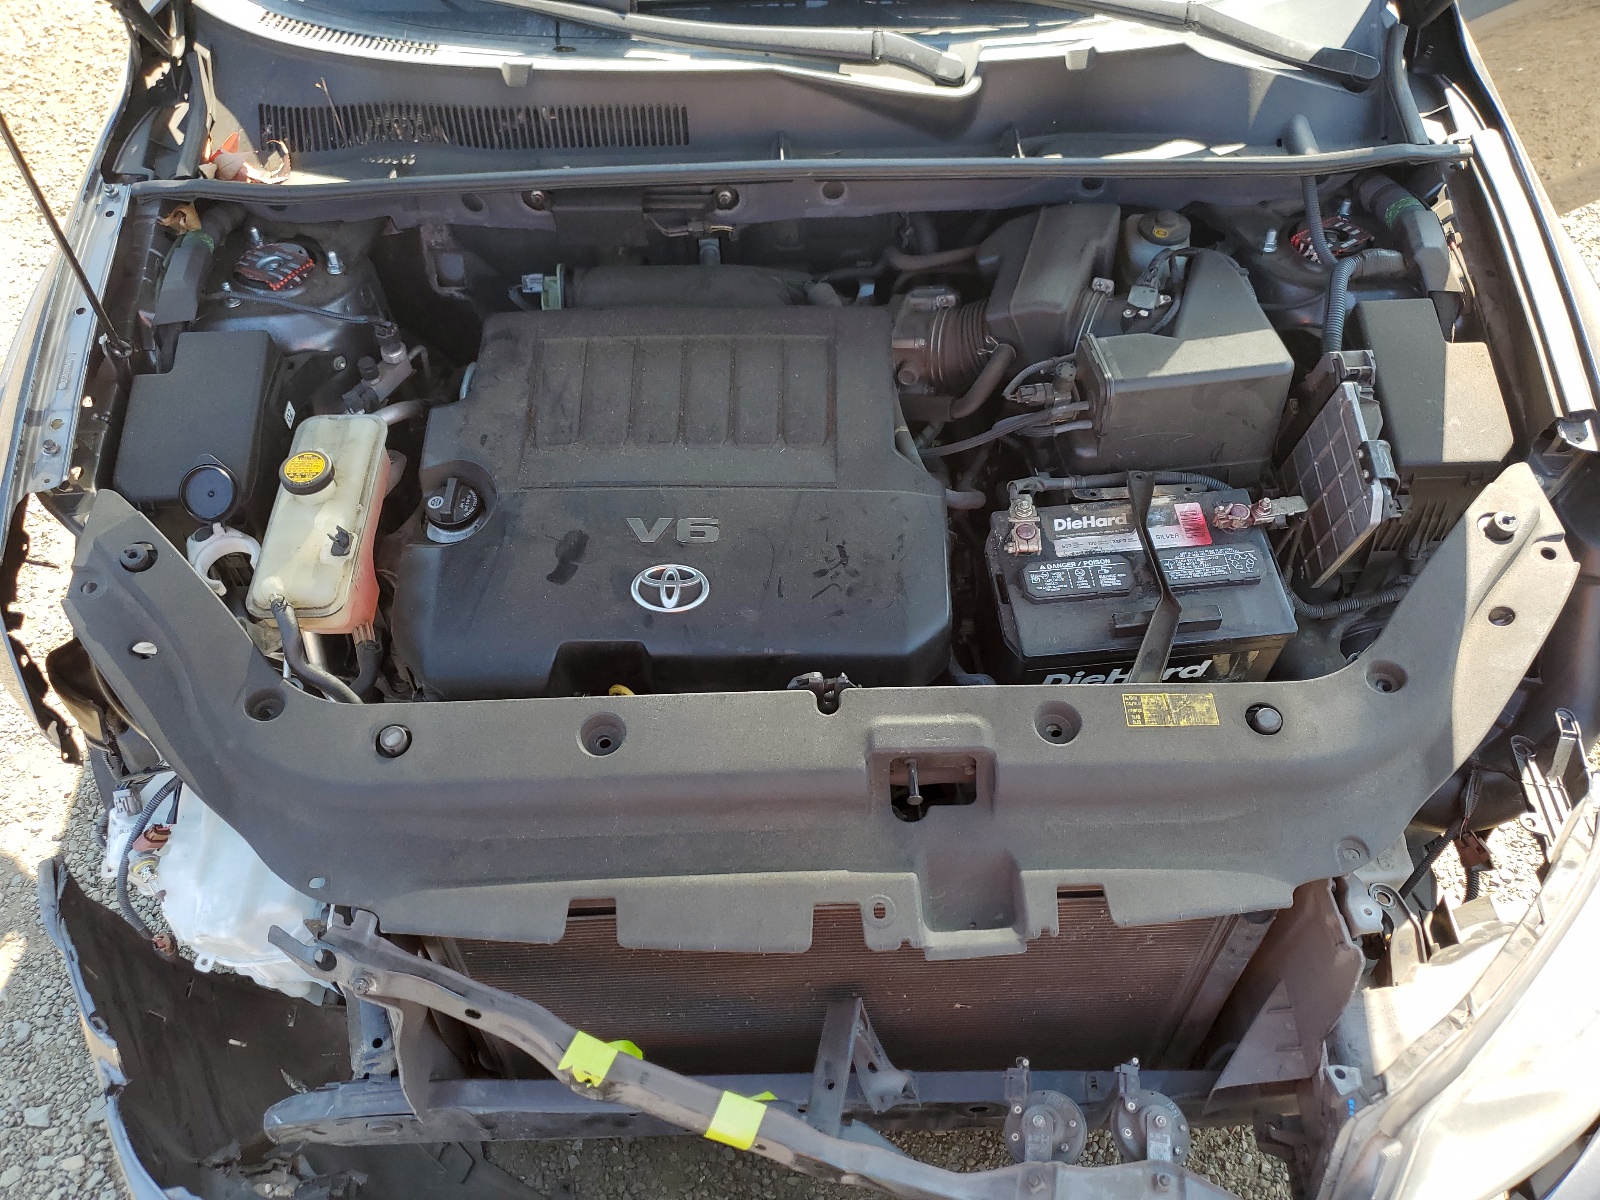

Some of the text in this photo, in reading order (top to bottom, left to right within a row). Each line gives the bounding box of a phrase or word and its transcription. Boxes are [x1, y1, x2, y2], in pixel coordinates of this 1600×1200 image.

[625, 517, 720, 544] V6
[1053, 512, 1128, 532] DieHard
[1155, 532, 1180, 540] SILVER
[1047, 561, 1076, 570] DANGER
[1083, 558, 1111, 566] POISON
[1042, 660, 1213, 684] DieHrd
